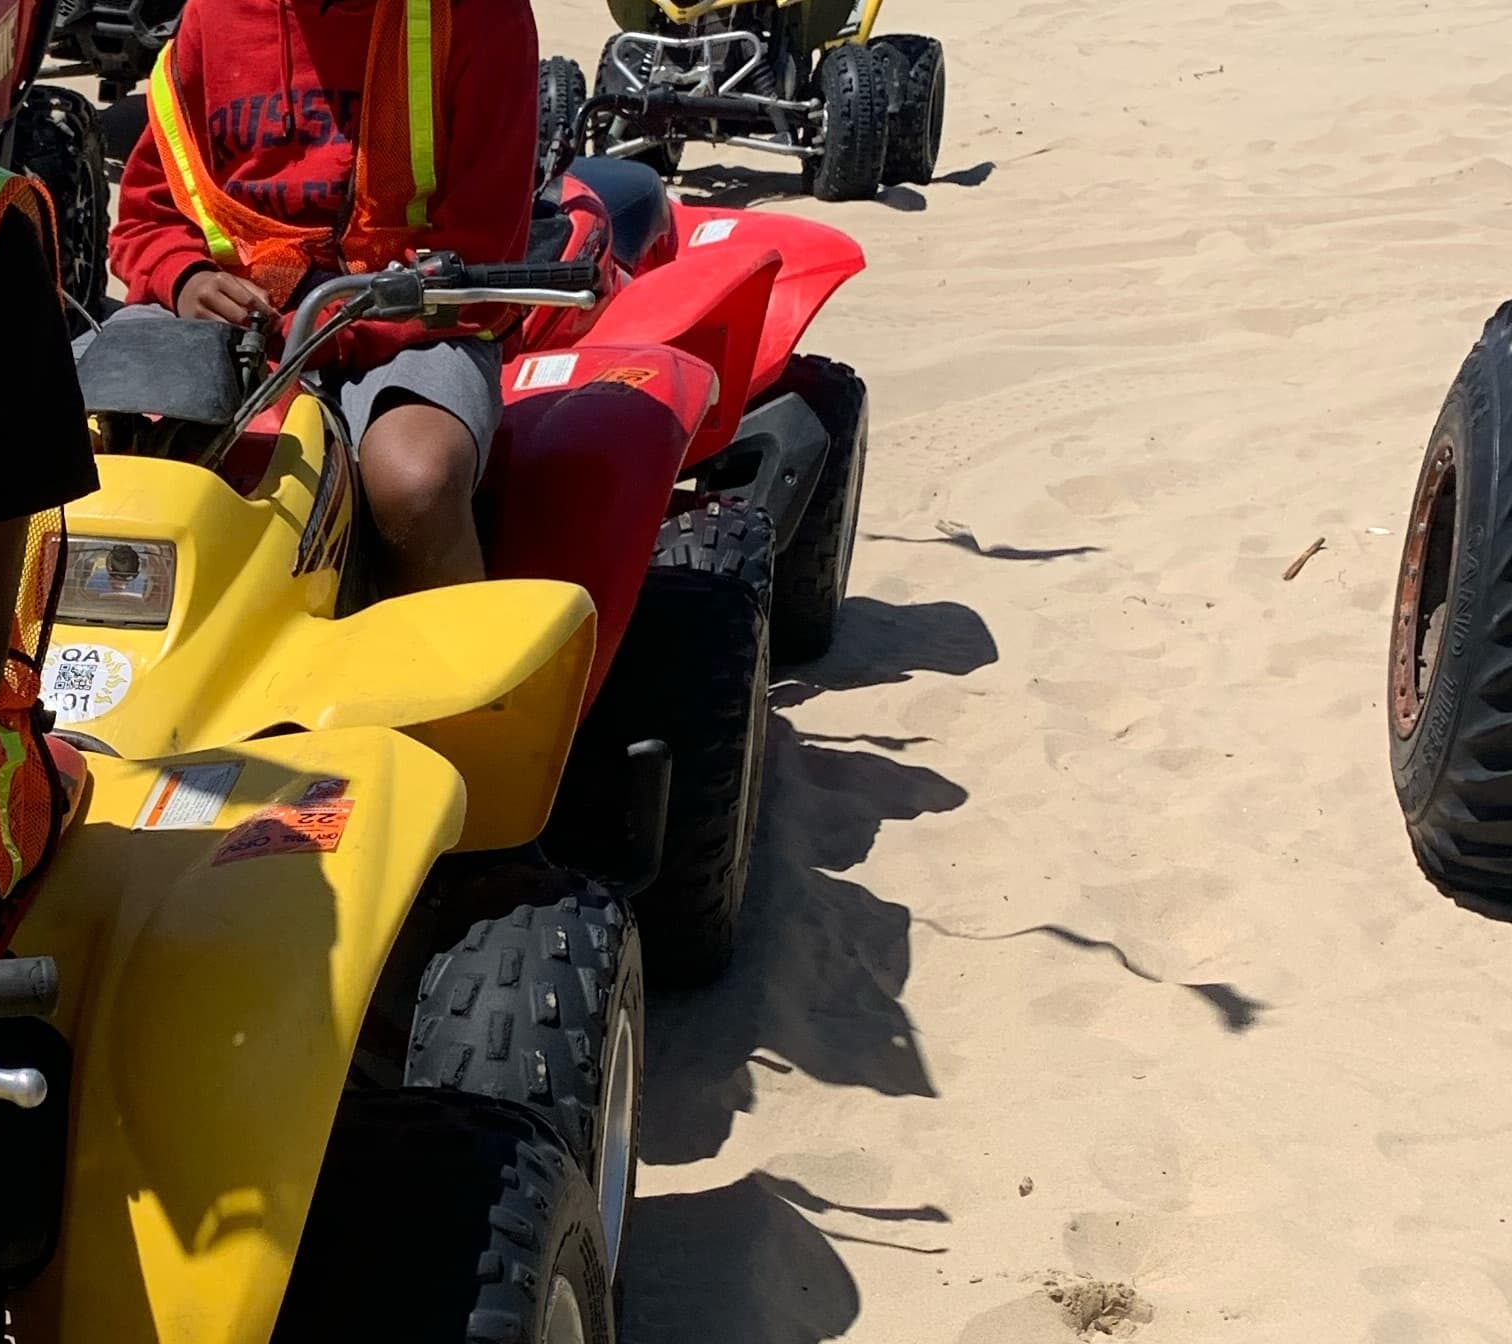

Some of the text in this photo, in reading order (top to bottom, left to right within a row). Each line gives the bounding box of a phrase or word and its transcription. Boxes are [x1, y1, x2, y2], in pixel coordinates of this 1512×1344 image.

[209, 89, 361, 171] RUSSE
[61, 648, 100, 663] QA
[298, 812, 335, 824] 22
